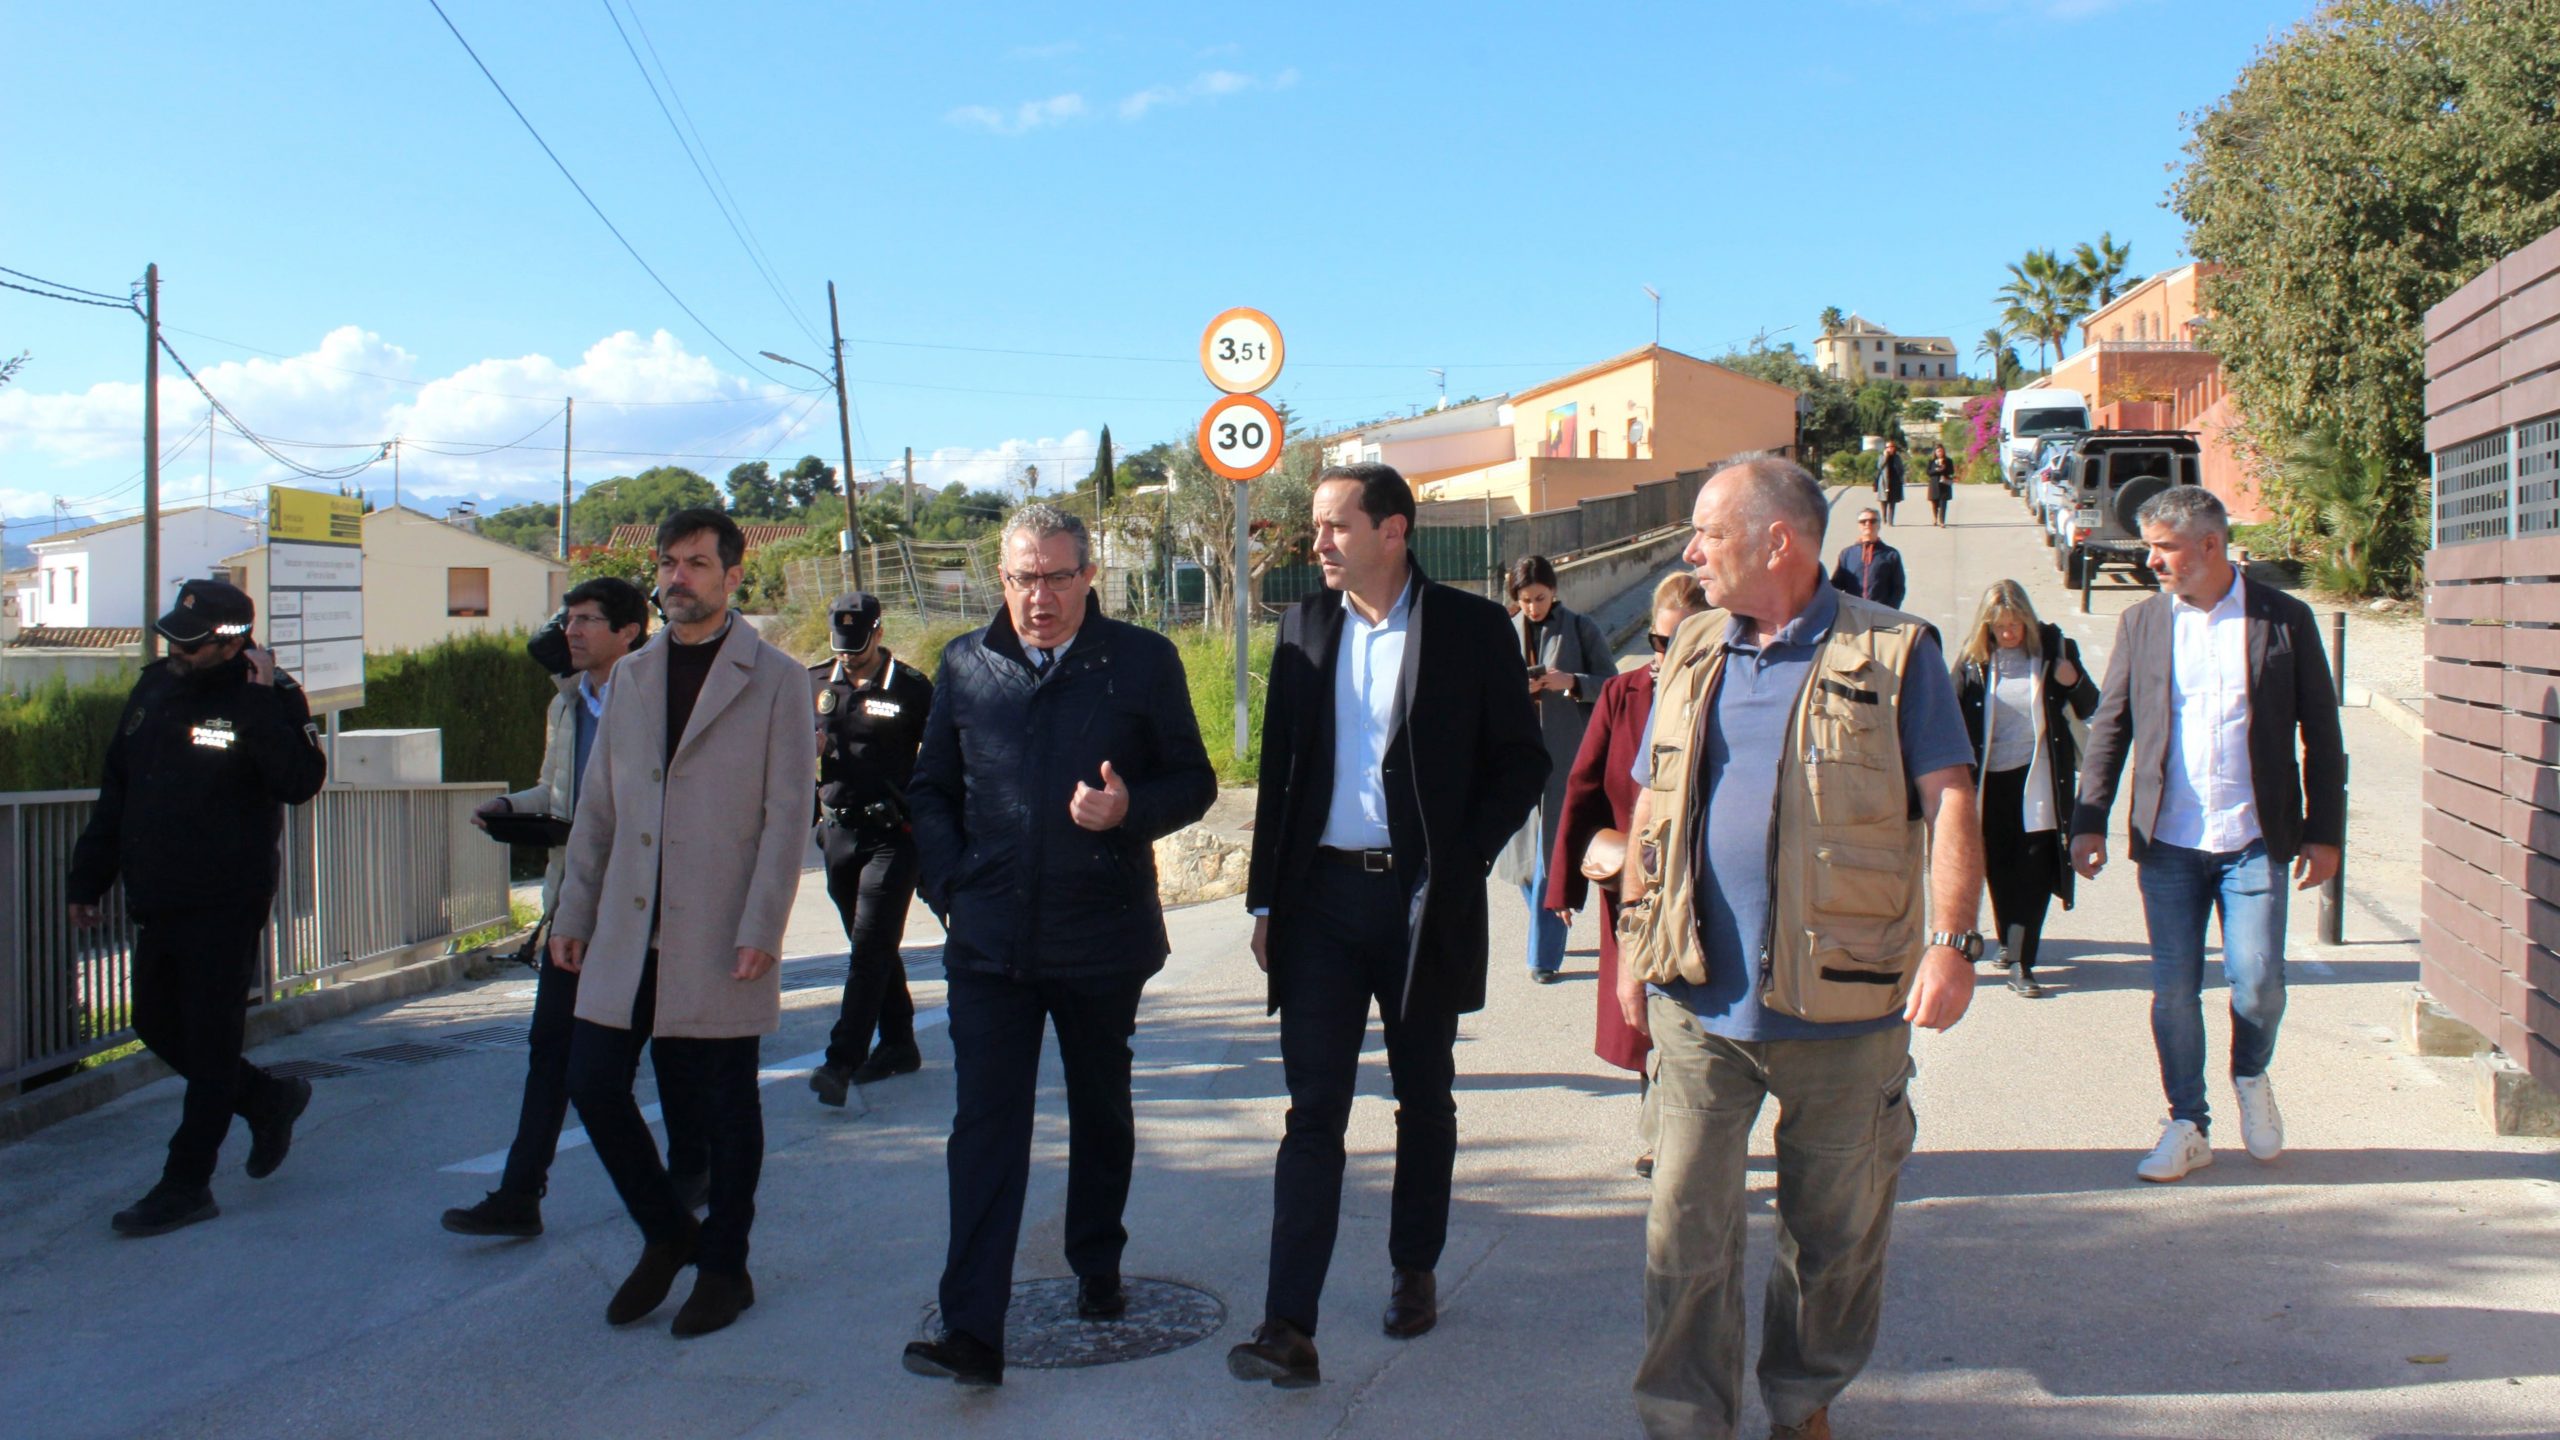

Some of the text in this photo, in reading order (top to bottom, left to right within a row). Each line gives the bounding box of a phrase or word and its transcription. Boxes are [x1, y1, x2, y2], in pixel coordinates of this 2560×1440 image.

[1217, 422, 1264, 450] 30
[866, 707, 896, 718] LOCAL
[193, 736, 228, 749] LOCAL
